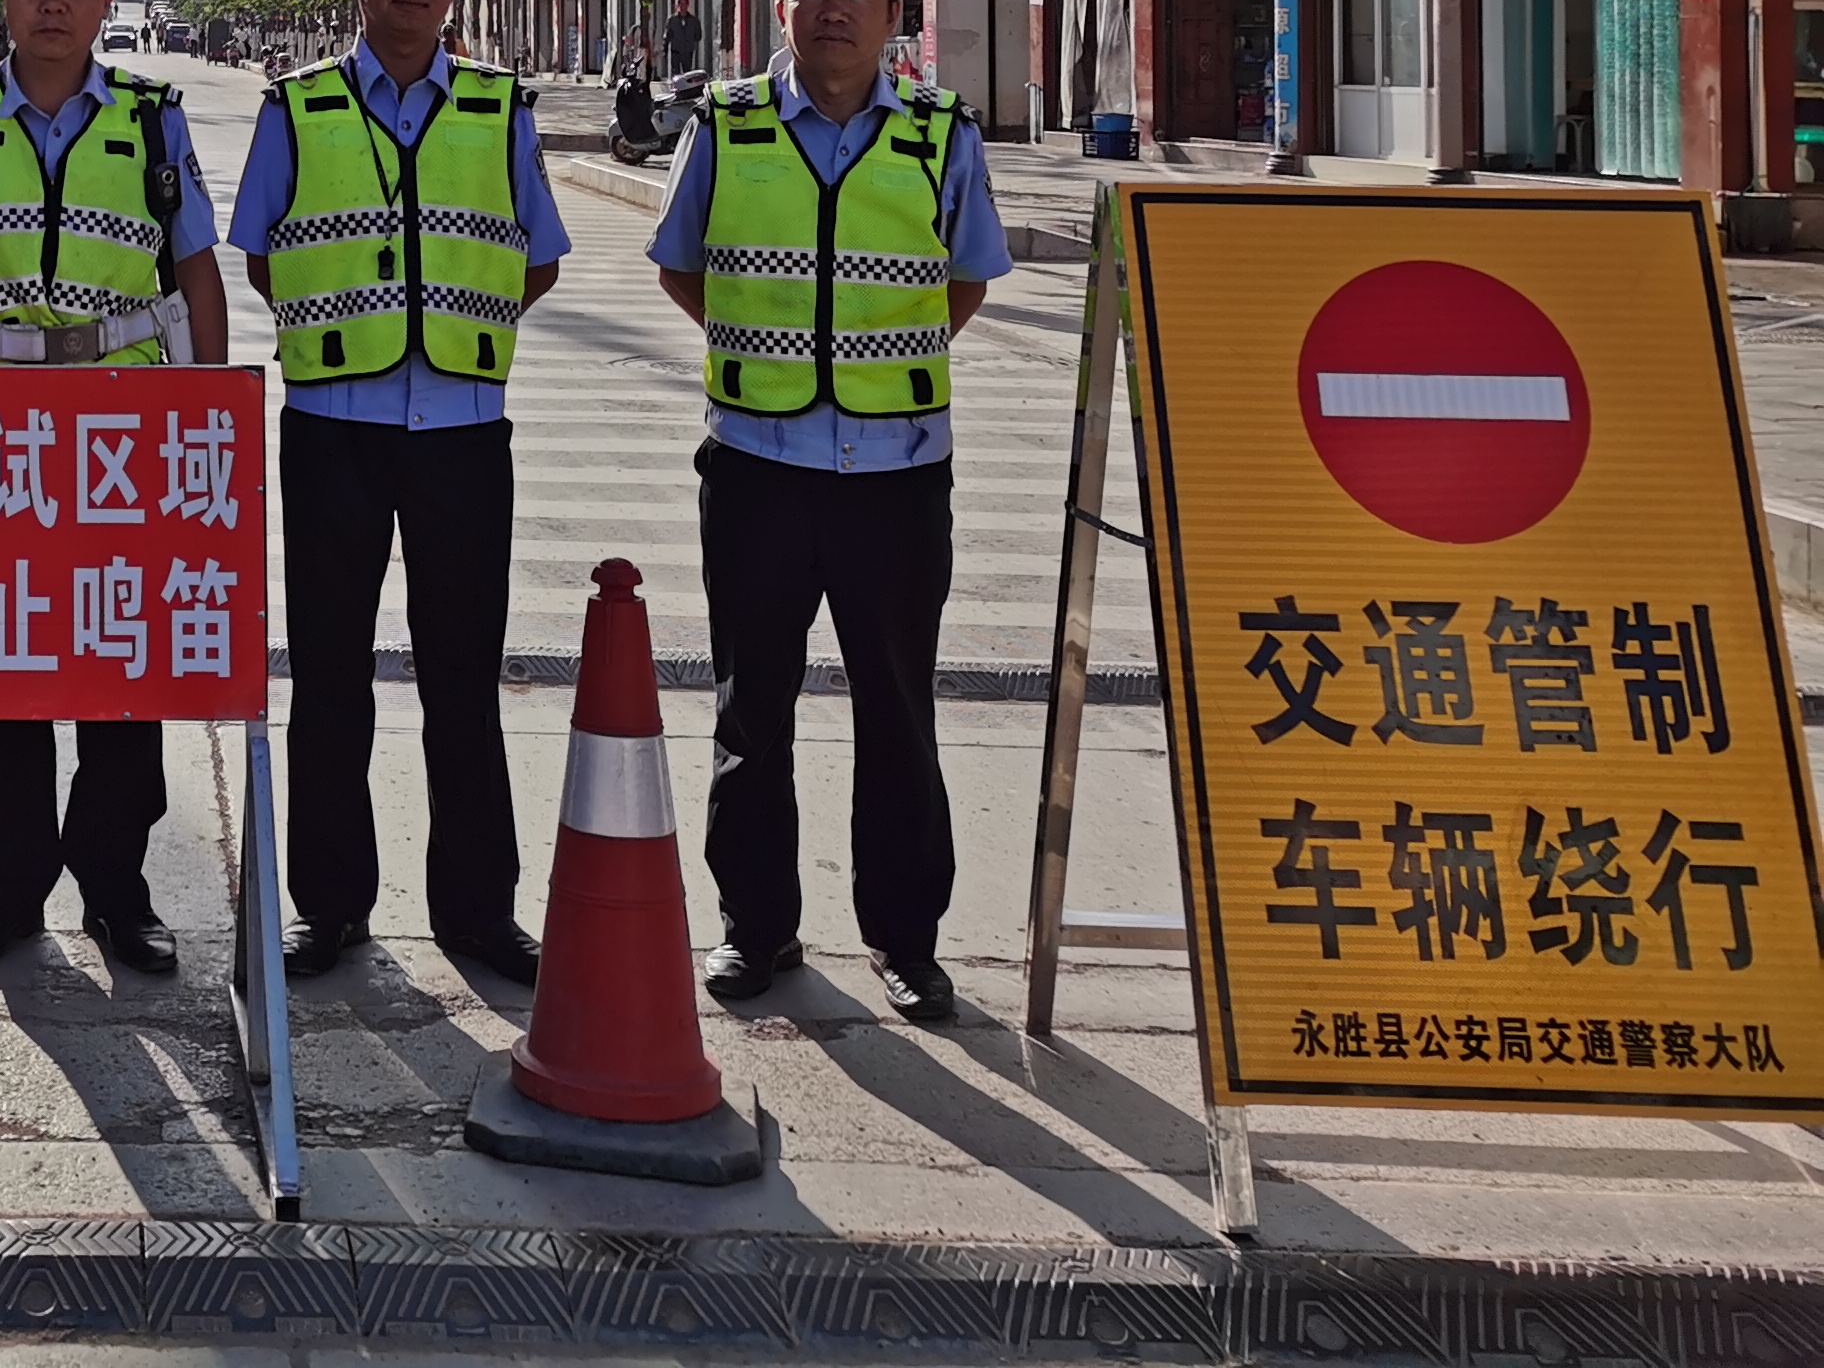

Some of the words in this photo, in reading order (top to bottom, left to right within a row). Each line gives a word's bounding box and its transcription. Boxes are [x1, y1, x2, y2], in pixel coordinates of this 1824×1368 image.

[1238, 595, 1733, 757] 交通管制
[1260, 798, 1760, 972] 车辆绕行
[1290, 1008, 1786, 1074] 永胜县公安局交通警察大队
